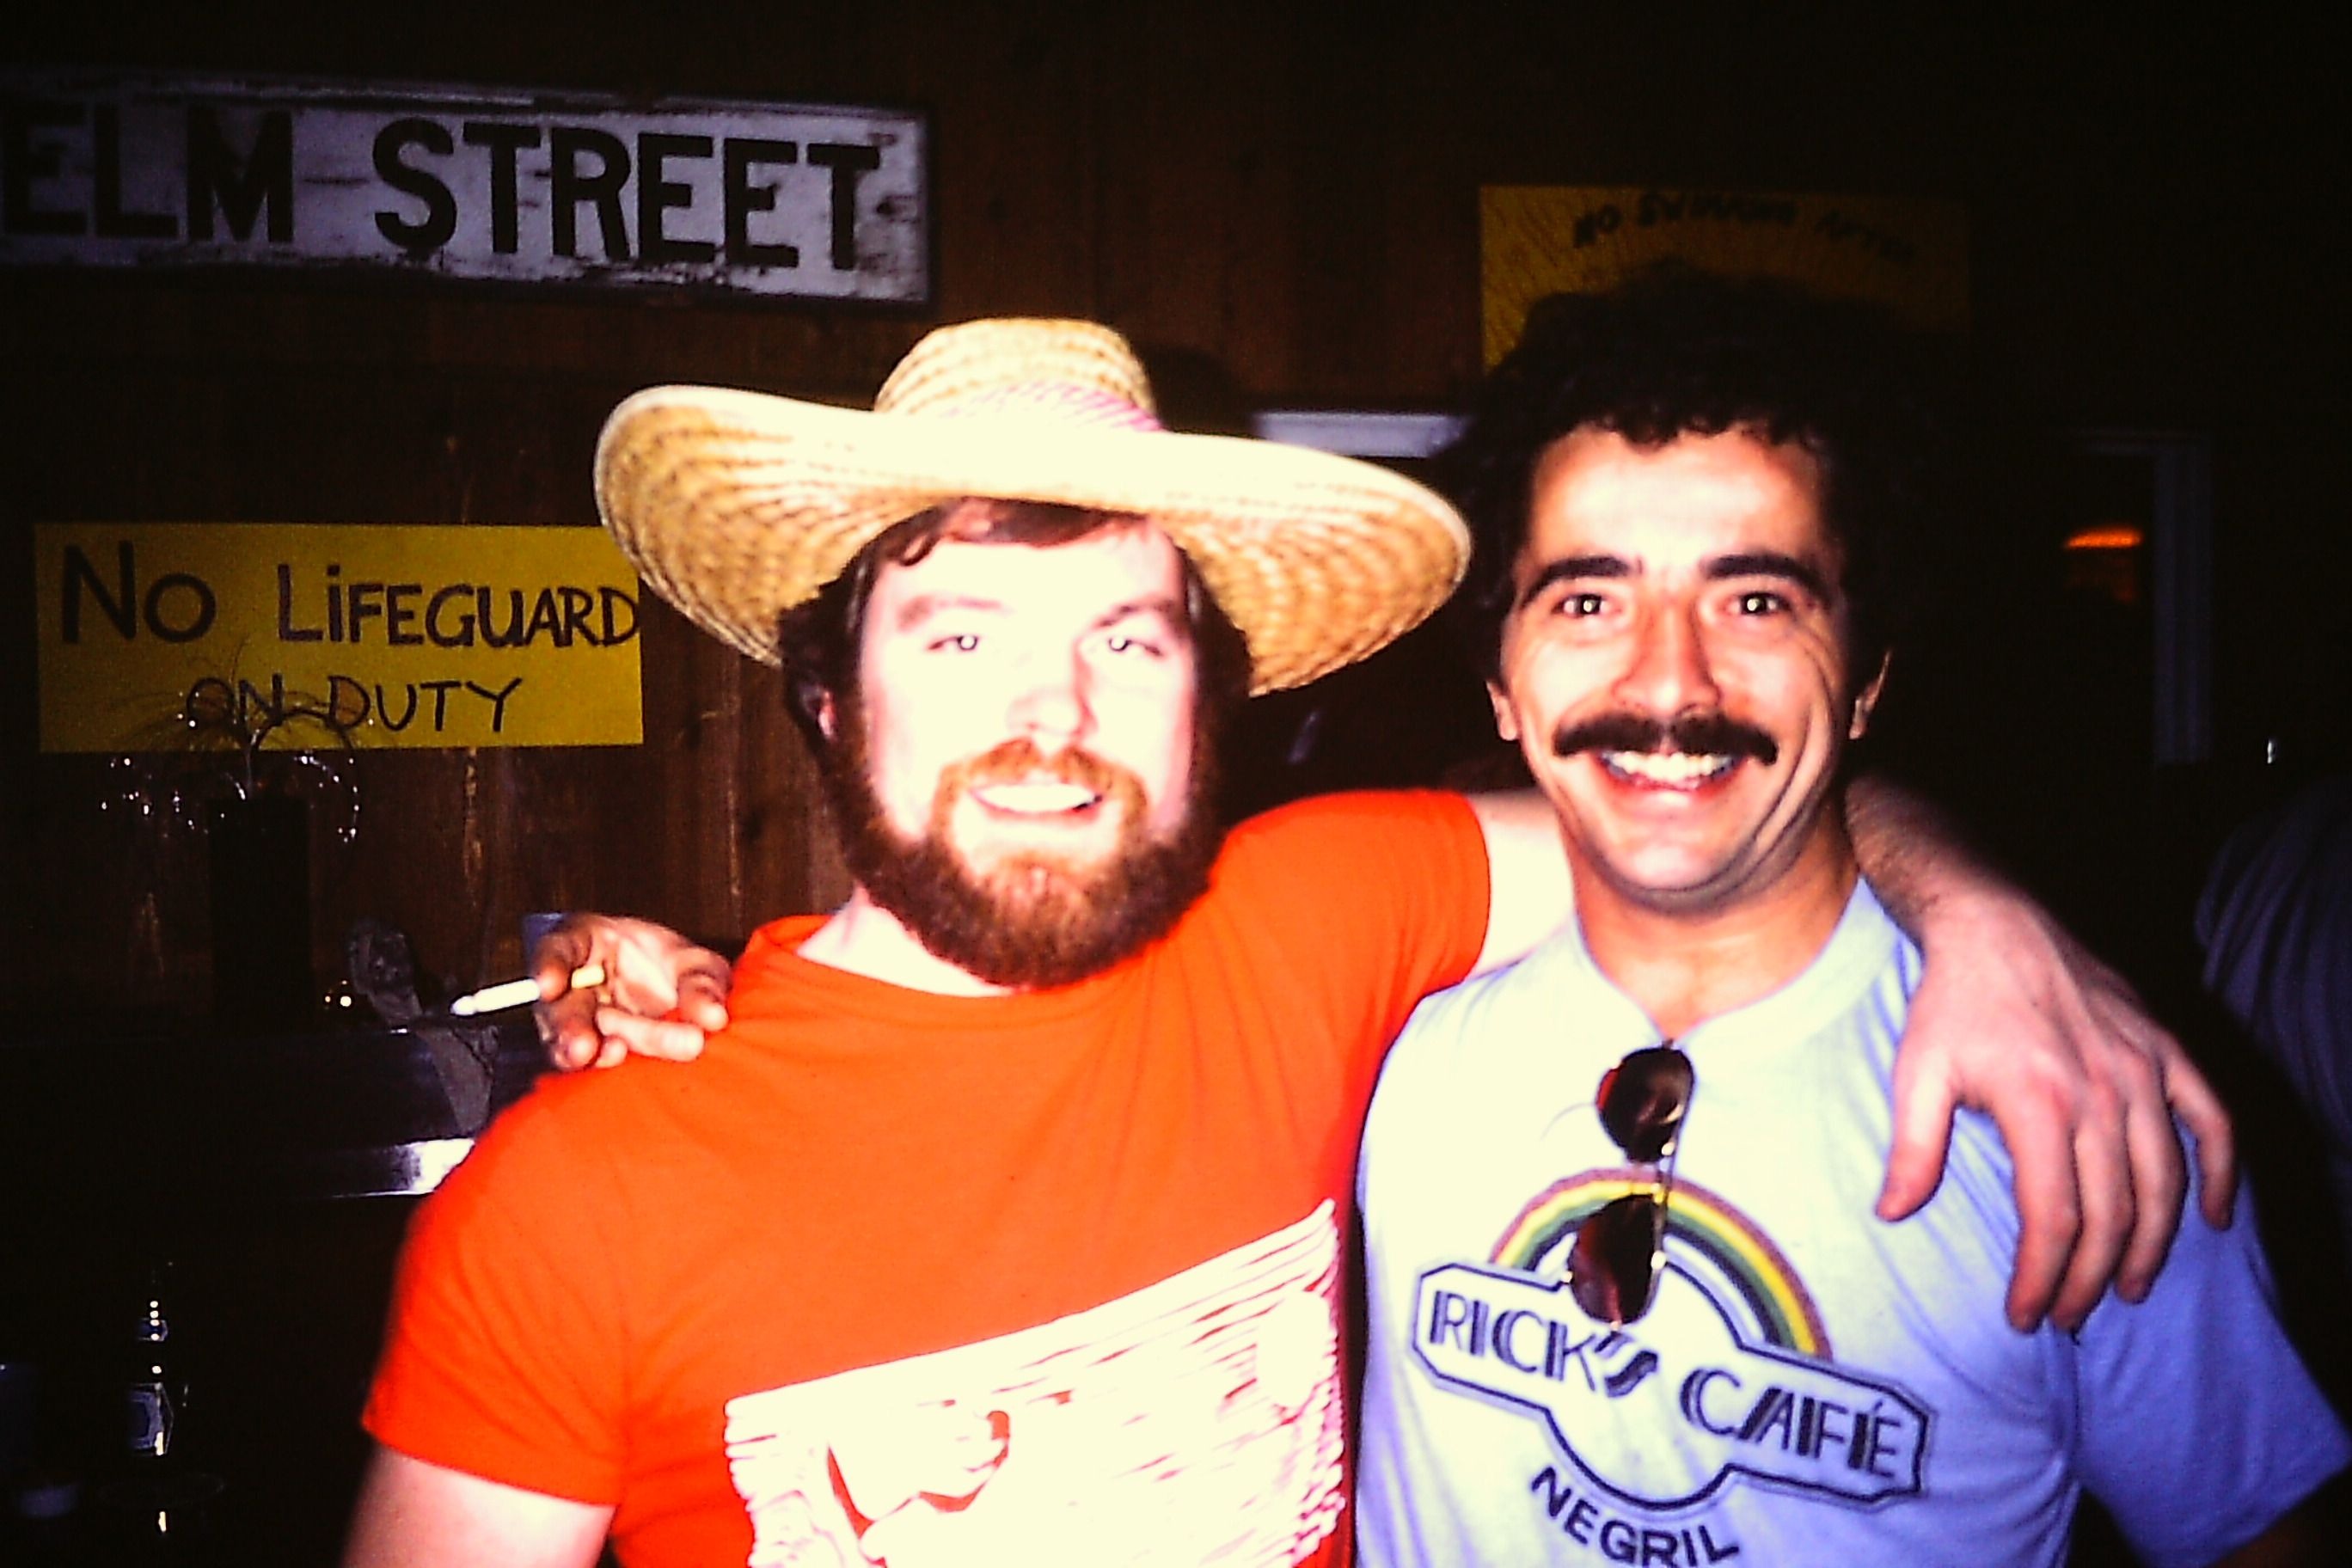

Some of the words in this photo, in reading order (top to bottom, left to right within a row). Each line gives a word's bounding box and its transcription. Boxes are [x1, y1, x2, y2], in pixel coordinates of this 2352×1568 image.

[3, 100, 293, 242] ELM
[371, 117, 882, 272] STREET
[186, 674, 284, 728] ON
[327, 675, 523, 732] DUTY
[1429, 1289, 1658, 1399] RICK'S
[1679, 1368, 1902, 1479] CAFÉ
[1531, 1466, 1740, 1568] NEGRIL
